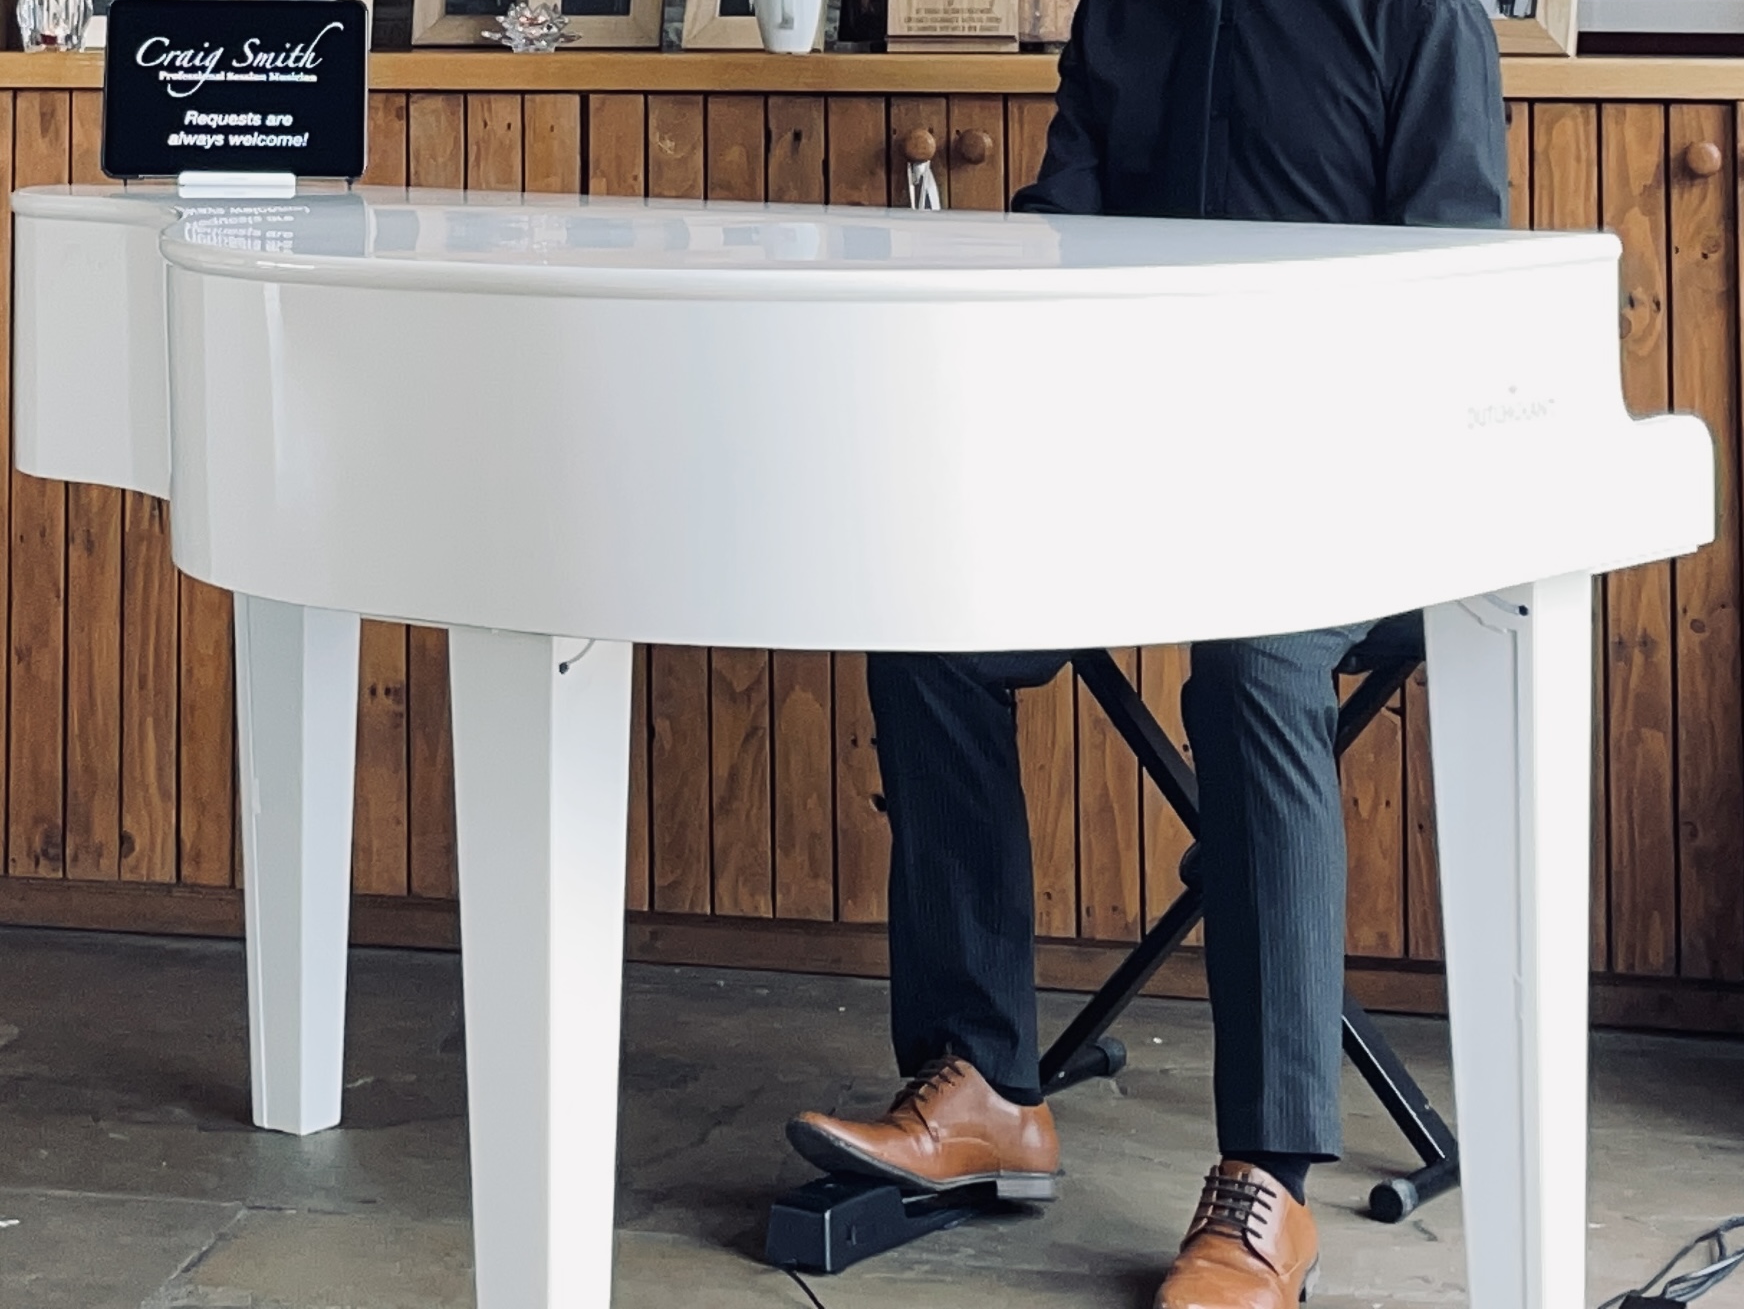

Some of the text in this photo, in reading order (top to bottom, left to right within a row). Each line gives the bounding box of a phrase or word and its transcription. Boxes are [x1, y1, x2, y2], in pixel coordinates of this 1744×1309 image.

[135, 21, 344, 98] Craig Smith
[158, 70, 225, 81] Professional
[268, 71, 318, 82] Musician
[184, 110, 294, 128] Requests are
[167, 131, 310, 149] always welcome!
